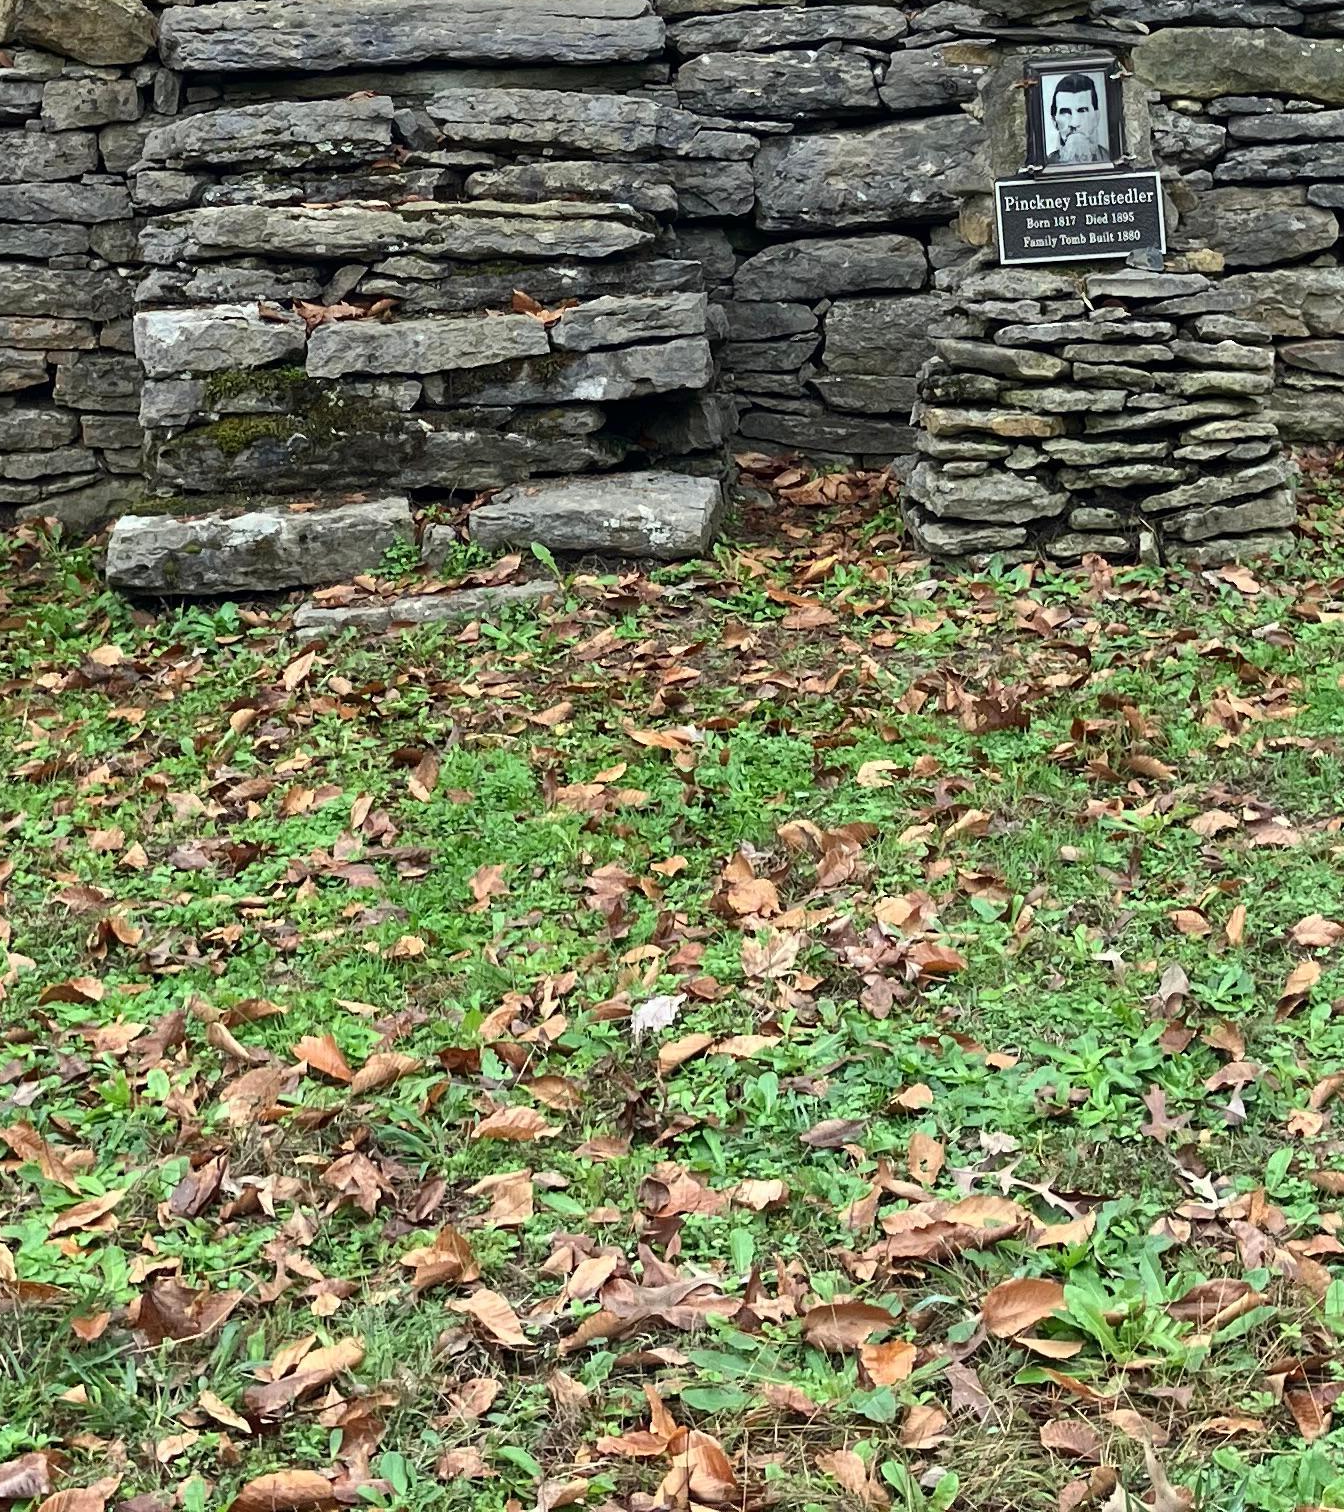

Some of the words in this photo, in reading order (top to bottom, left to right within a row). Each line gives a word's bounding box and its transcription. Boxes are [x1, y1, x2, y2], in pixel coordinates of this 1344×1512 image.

[1004, 194, 1071, 212] Pinckney
[1075, 188, 1154, 207] Hufstedler
[1026, 218, 1051, 229] Born
[1054, 216, 1077, 227] 1817
[1086, 213, 1109, 225] Died
[1112, 212, 1135, 224] 1895
[1024, 235, 1058, 248] Family
[1059, 233, 1087, 246] Tomb
[1089, 232, 1115, 244] Built
[1117, 230, 1141, 242] 1880
